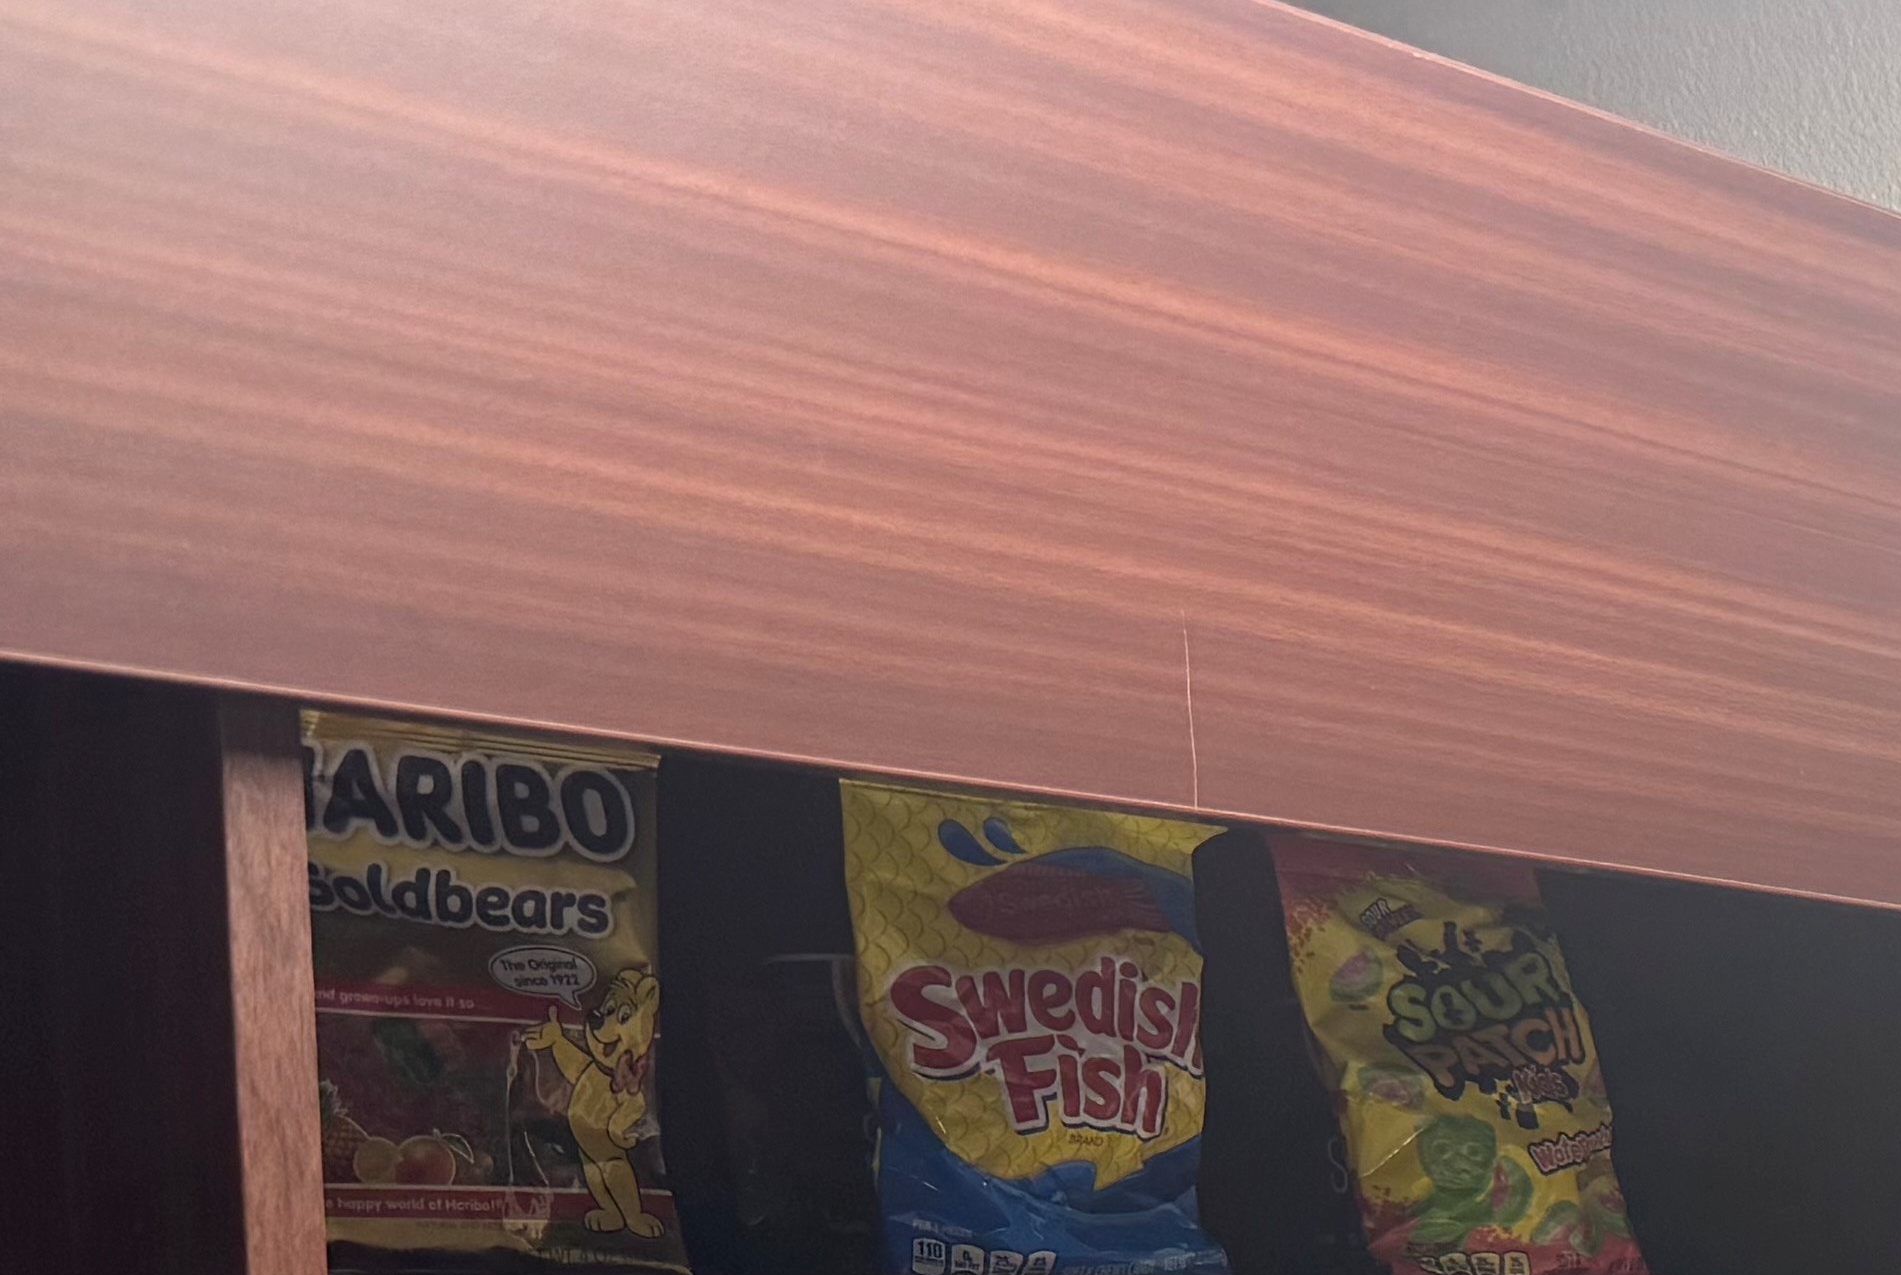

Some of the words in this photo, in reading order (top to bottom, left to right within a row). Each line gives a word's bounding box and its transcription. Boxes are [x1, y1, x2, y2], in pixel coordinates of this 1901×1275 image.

[1388, 950, 1562, 1044] SOUR
[985, 1033, 1165, 1135] Fish
[1412, 1006, 1585, 1088] PATCH
